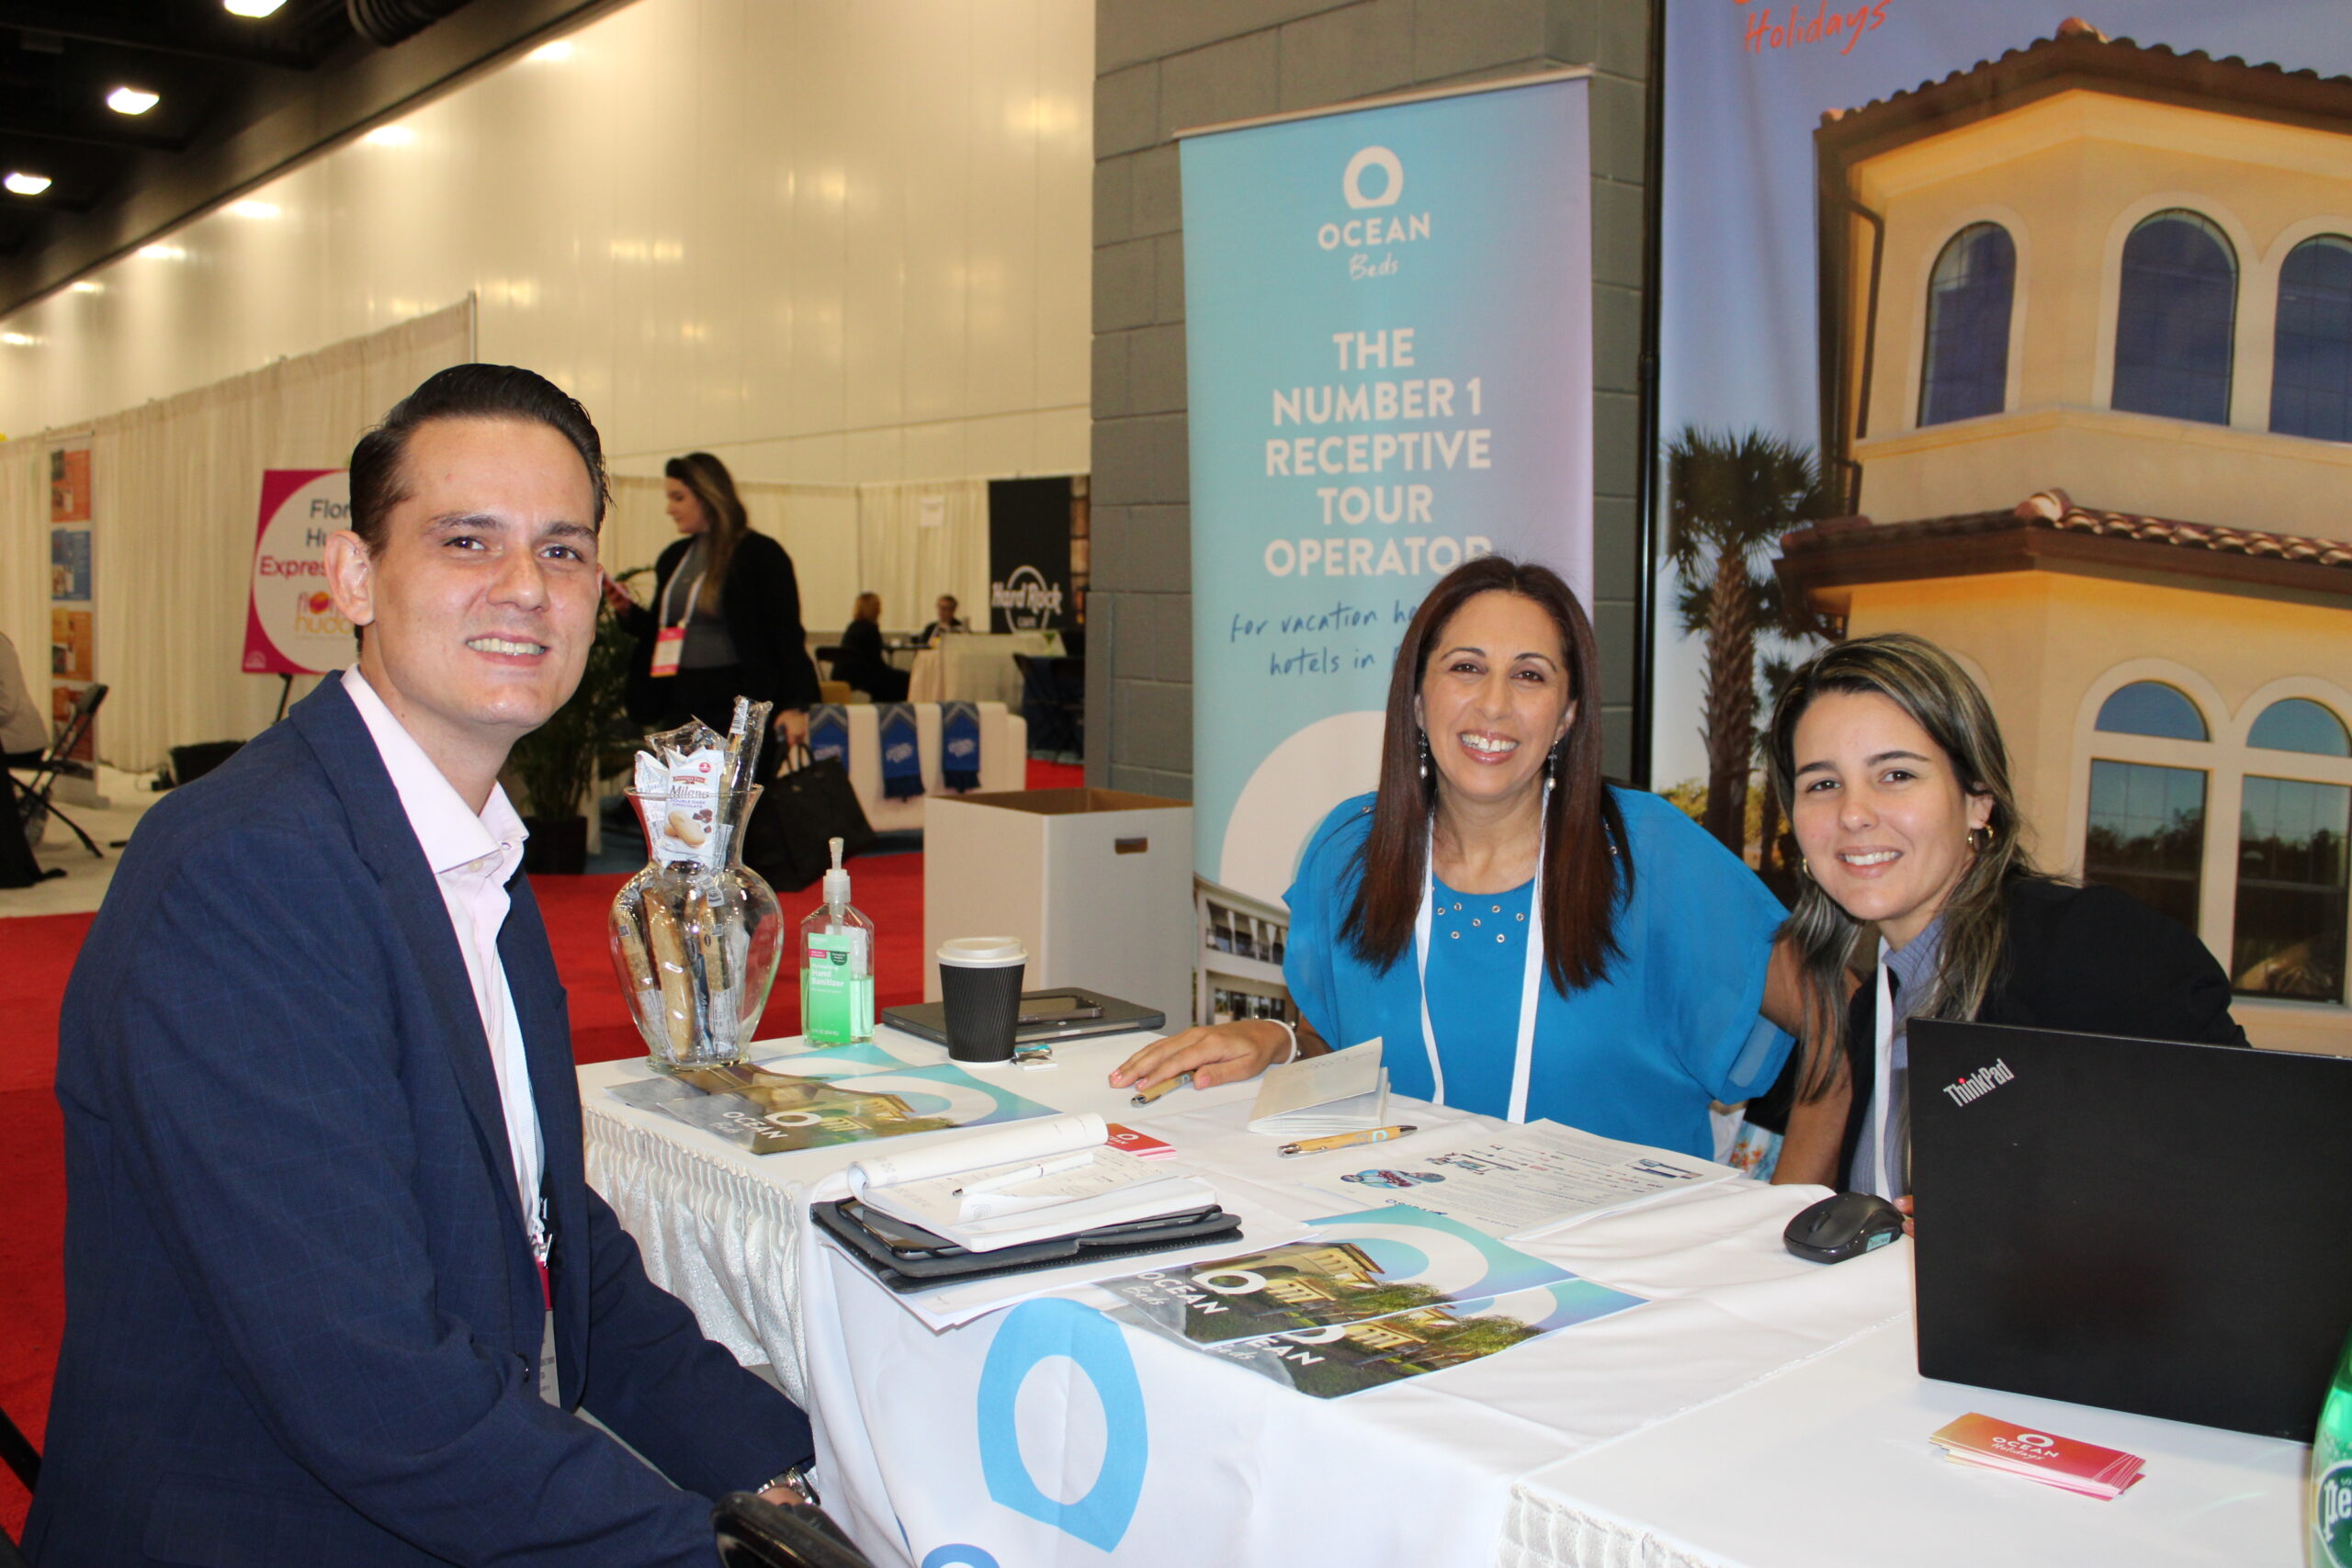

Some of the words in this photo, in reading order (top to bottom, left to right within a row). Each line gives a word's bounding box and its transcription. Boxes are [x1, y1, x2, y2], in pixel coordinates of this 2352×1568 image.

[1745, 0, 1893, 55] Holidays
[1317, 212, 1430, 250] OCEAN
[1348, 252, 1398, 280] Beds
[1332, 328, 1415, 370] THE
[1272, 378, 1454, 425] NUMBER
[1467, 378, 1482, 415] 1
[1266, 428, 1491, 476] RECEPTIVE
[310, 498, 351, 519] Flor
[1317, 484, 1433, 525] TOUR
[260, 555, 327, 580] Expres
[991, 581, 1026, 608] Hard
[1026, 581, 1063, 615] Rock
[1230, 613, 1269, 643] for
[1282, 601, 1378, 633] vacation
[1270, 647, 1340, 676] hotels
[1353, 649, 1375, 669] in
[669, 785, 709, 799] Milano
[1942, 1057, 2015, 1108] ThinkPad
[722, 1111, 788, 1139] OCEAN
[1136, 1272, 1229, 1314] OCEAN
[1245, 1337, 1326, 1366] EAN
[1992, 1437, 2060, 1459] OCEAN
